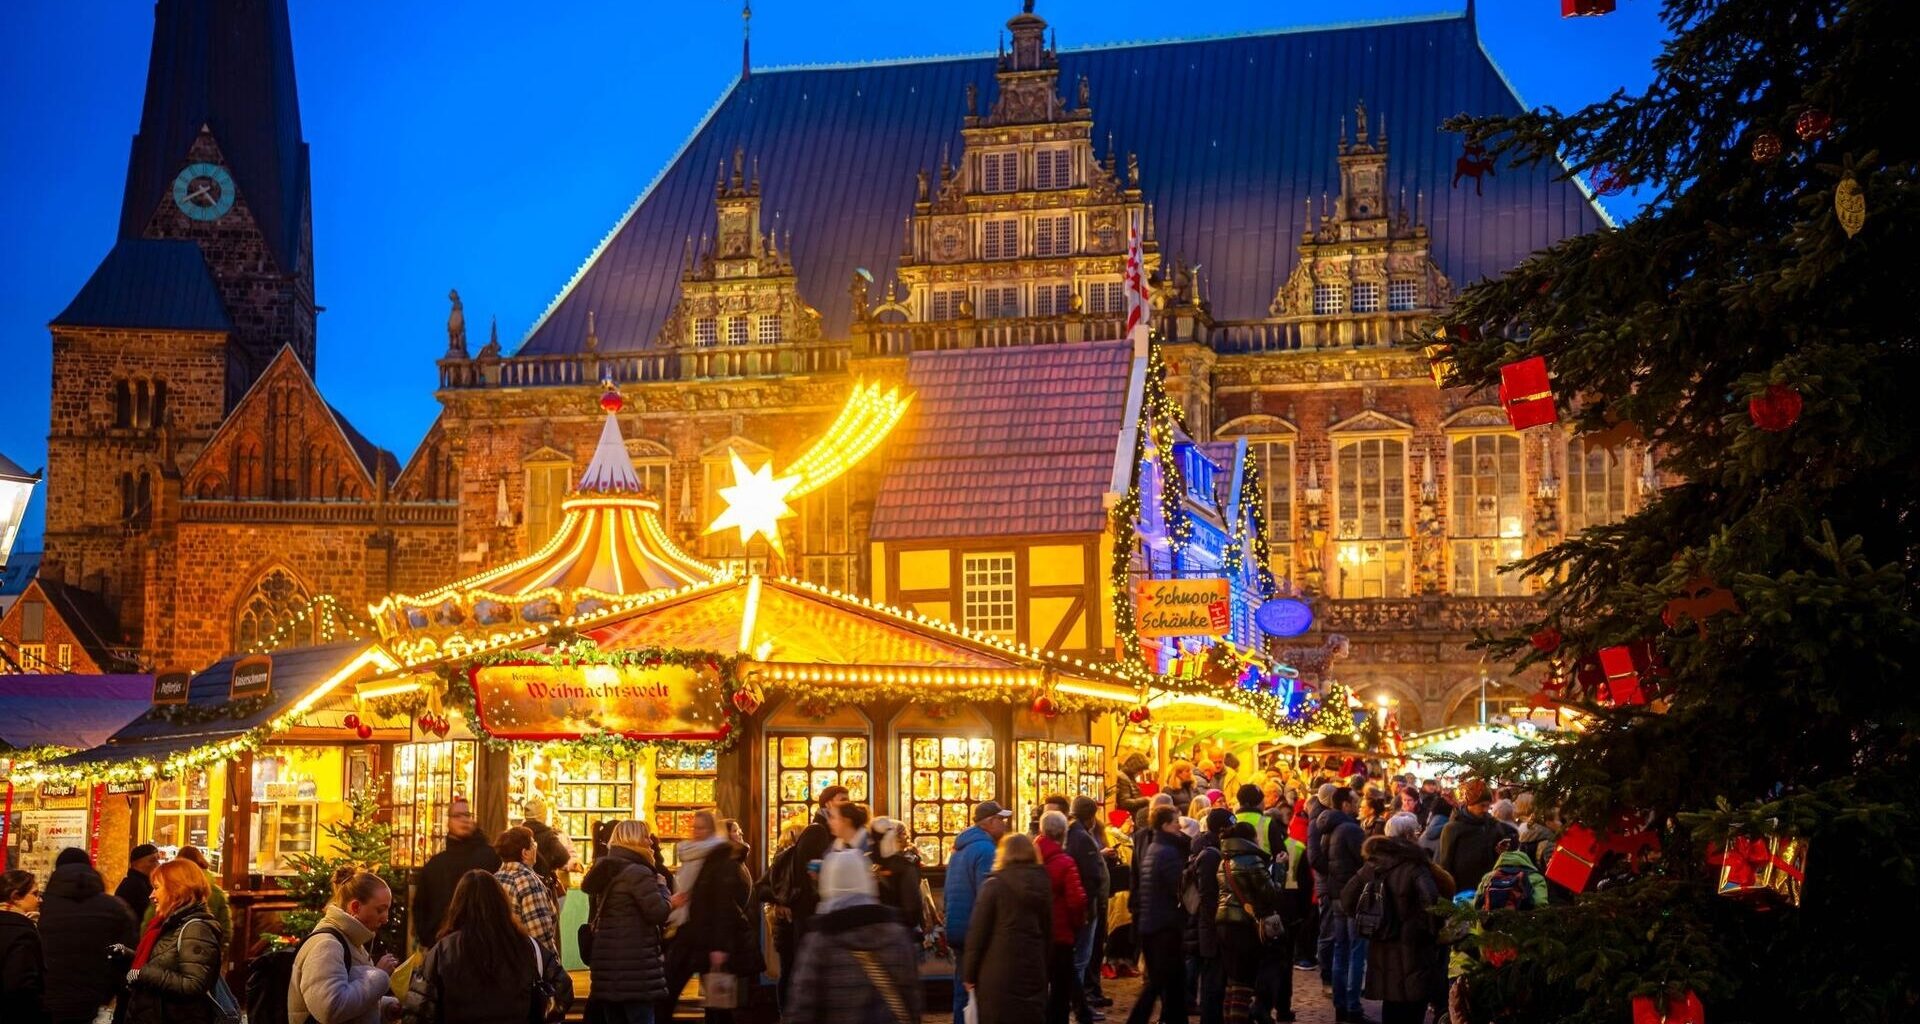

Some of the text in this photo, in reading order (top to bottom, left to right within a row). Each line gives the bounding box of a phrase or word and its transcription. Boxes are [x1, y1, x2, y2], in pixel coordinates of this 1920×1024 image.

[1154, 585, 1227, 606] Schnoor-
[1141, 609, 1209, 630] Schänke
[526, 681, 669, 699] Weihnachtswelt
